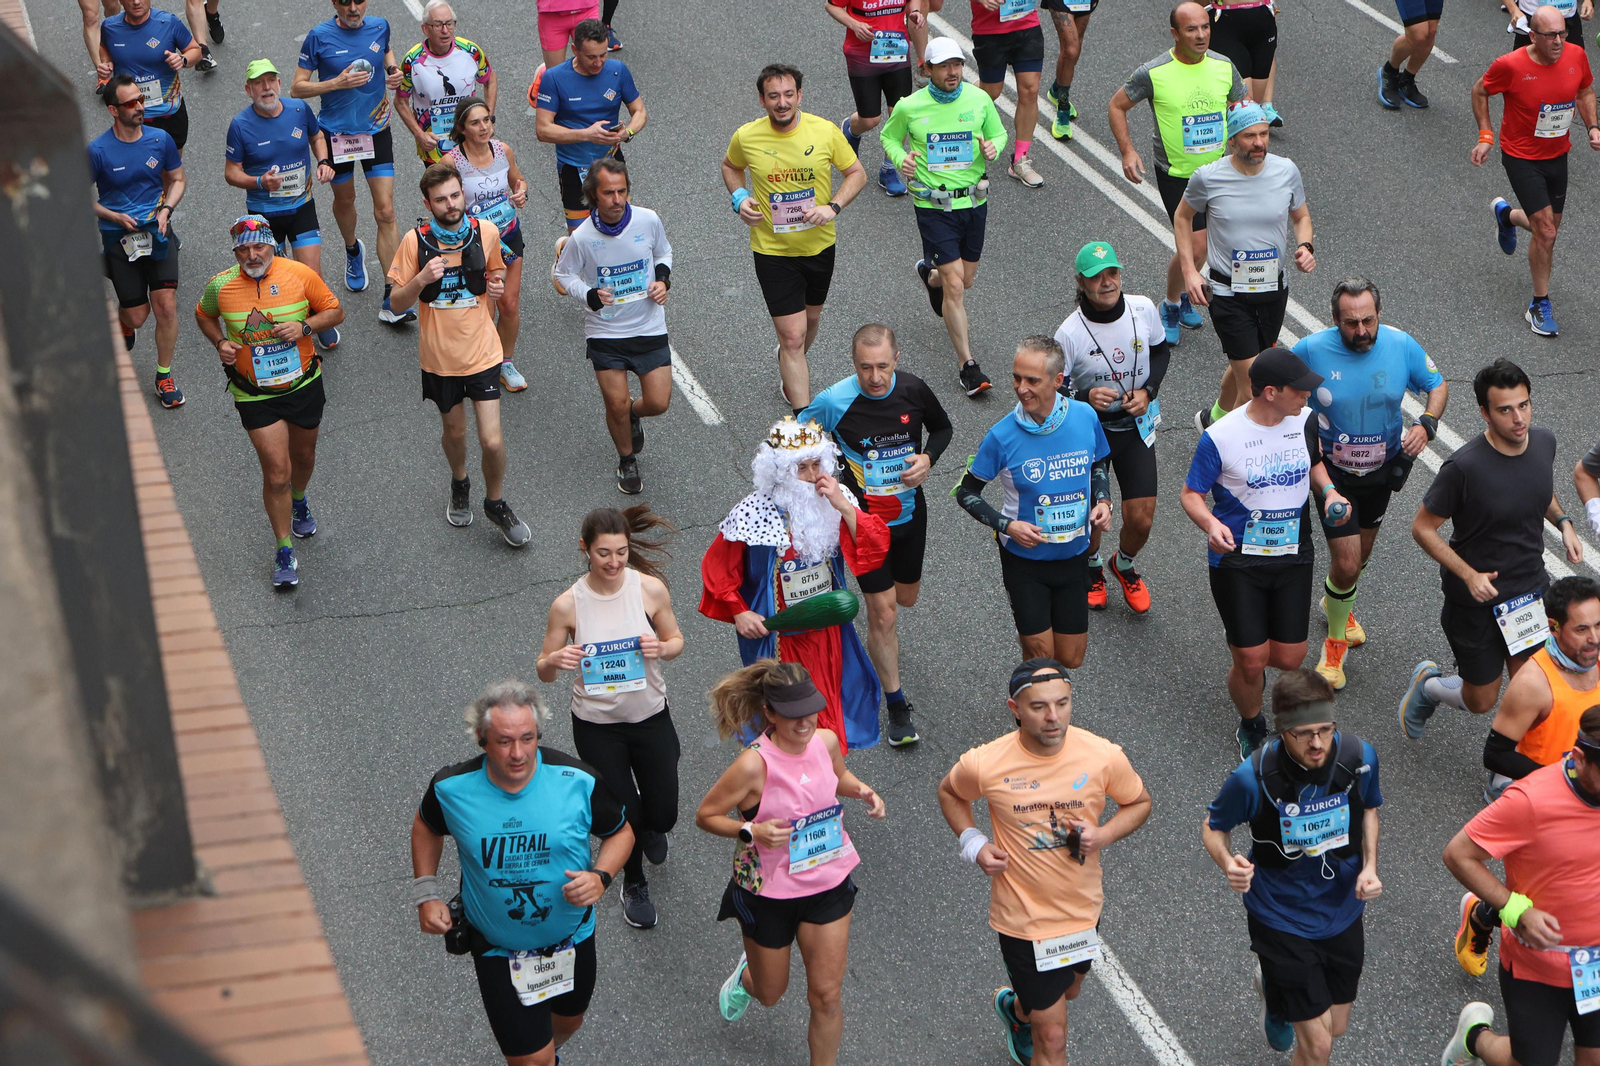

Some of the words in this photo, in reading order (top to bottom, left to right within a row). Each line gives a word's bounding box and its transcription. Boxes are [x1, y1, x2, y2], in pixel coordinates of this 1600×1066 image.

[135, 74, 155, 82] ZURICH
[282, 161, 302, 170] ZURICH
[767, 172, 815, 183] SEVILLA
[785, 191, 810, 200] ZURICH
[483, 196, 503, 209] ZURICH
[486, 210, 502, 220] 11609
[613, 264, 638, 274] ZURICH
[613, 278, 632, 287] 11400
[267, 342, 292, 353] ZURICH
[267, 356, 287, 367] 11329
[270, 367, 288, 376] PARDO
[874, 434, 910, 443] CaixaBank
[1245, 439, 1263, 448] GOBIK
[882, 447, 909, 458] ZURICH
[1061, 450, 1088, 458] DEPORTIVO
[1245, 447, 1306, 469] RUNNERS
[880, 464, 903, 474] 12008
[1048, 458, 1089, 470] AUTISMO
[1247, 469, 1259, 483] la
[1263, 456, 1308, 474] Palmera
[1049, 469, 1086, 480] SEVILLA
[1053, 493, 1082, 503] ZURICH
[1052, 510, 1075, 520] 11152
[1051, 523, 1077, 532] ENRIQUE
[802, 573, 819, 584] 8715
[800, 589, 808, 597] TIO
[817, 580, 829, 592] MAZO
[1511, 592, 1537, 609] ZURICH
[1515, 612, 1533, 625] 9929
[1517, 626, 1532, 638] JAIME
[600, 641, 634, 653] ZURICH
[600, 659, 626, 670] 12240
[603, 673, 626, 682] MARIA
[1014, 803, 1048, 812] Maratón
[1055, 800, 1083, 808] Sevilla
[1304, 797, 1341, 813] ZURICH
[808, 808, 836, 825] ZURICH
[502, 820, 522, 828] HORIZON
[1302, 818, 1330, 832] 10672
[804, 829, 826, 843] 11606
[1287, 837, 1313, 845] HAUKE
[480, 836, 505, 869] VI
[509, 833, 551, 853] TRAIL
[807, 844, 826, 856] ALICIA
[505, 854, 523, 862] CIUDAD
[505, 861, 523, 869] SIERRA
[1046, 946, 1057, 955] Rui
[1059, 940, 1088, 952] Medeiros
[534, 961, 556, 974] 9693
[527, 978, 550, 990] Ignacio
